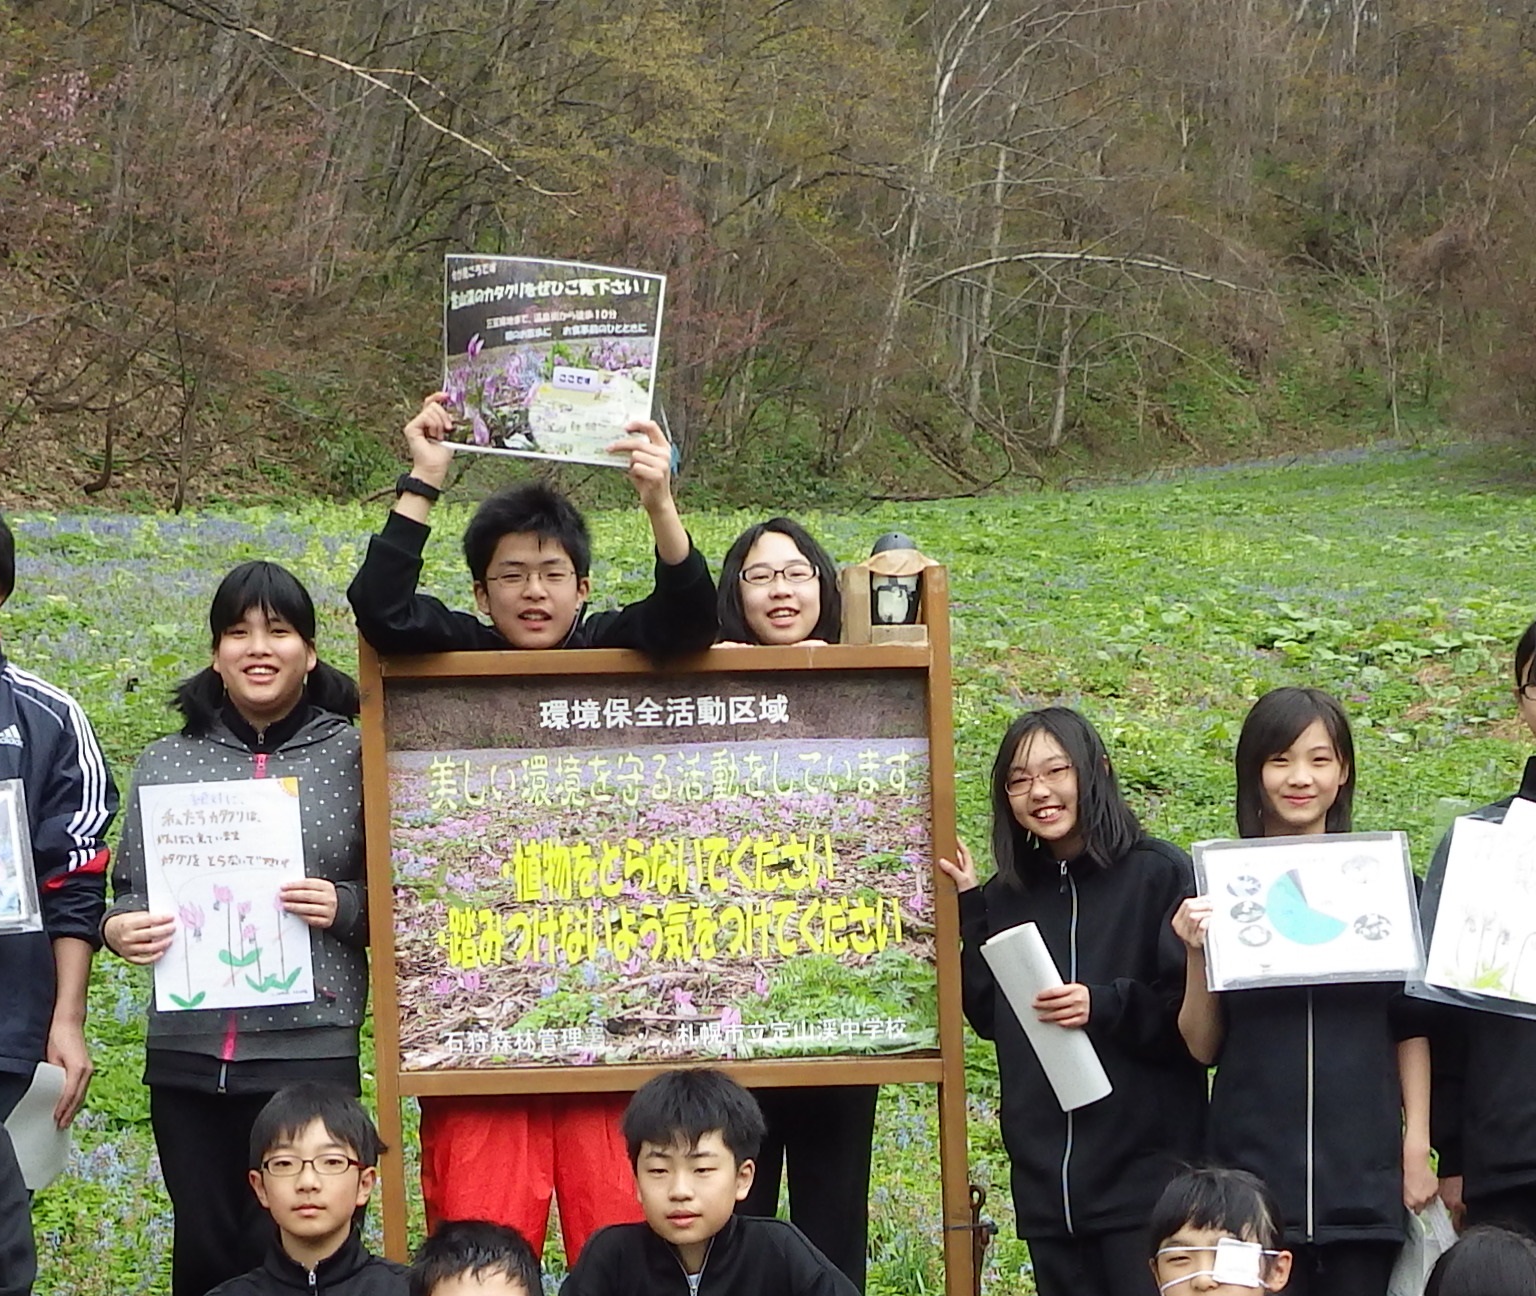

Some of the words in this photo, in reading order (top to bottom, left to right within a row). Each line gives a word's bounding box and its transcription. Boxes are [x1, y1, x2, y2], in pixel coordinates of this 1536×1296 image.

[539, 695, 790, 731] 環境保全活動区域
[428, 748, 910, 810] 美しい環境を守る活動をしています
[677, 1016, 908, 1047] 札幌市立定山渓中学校
